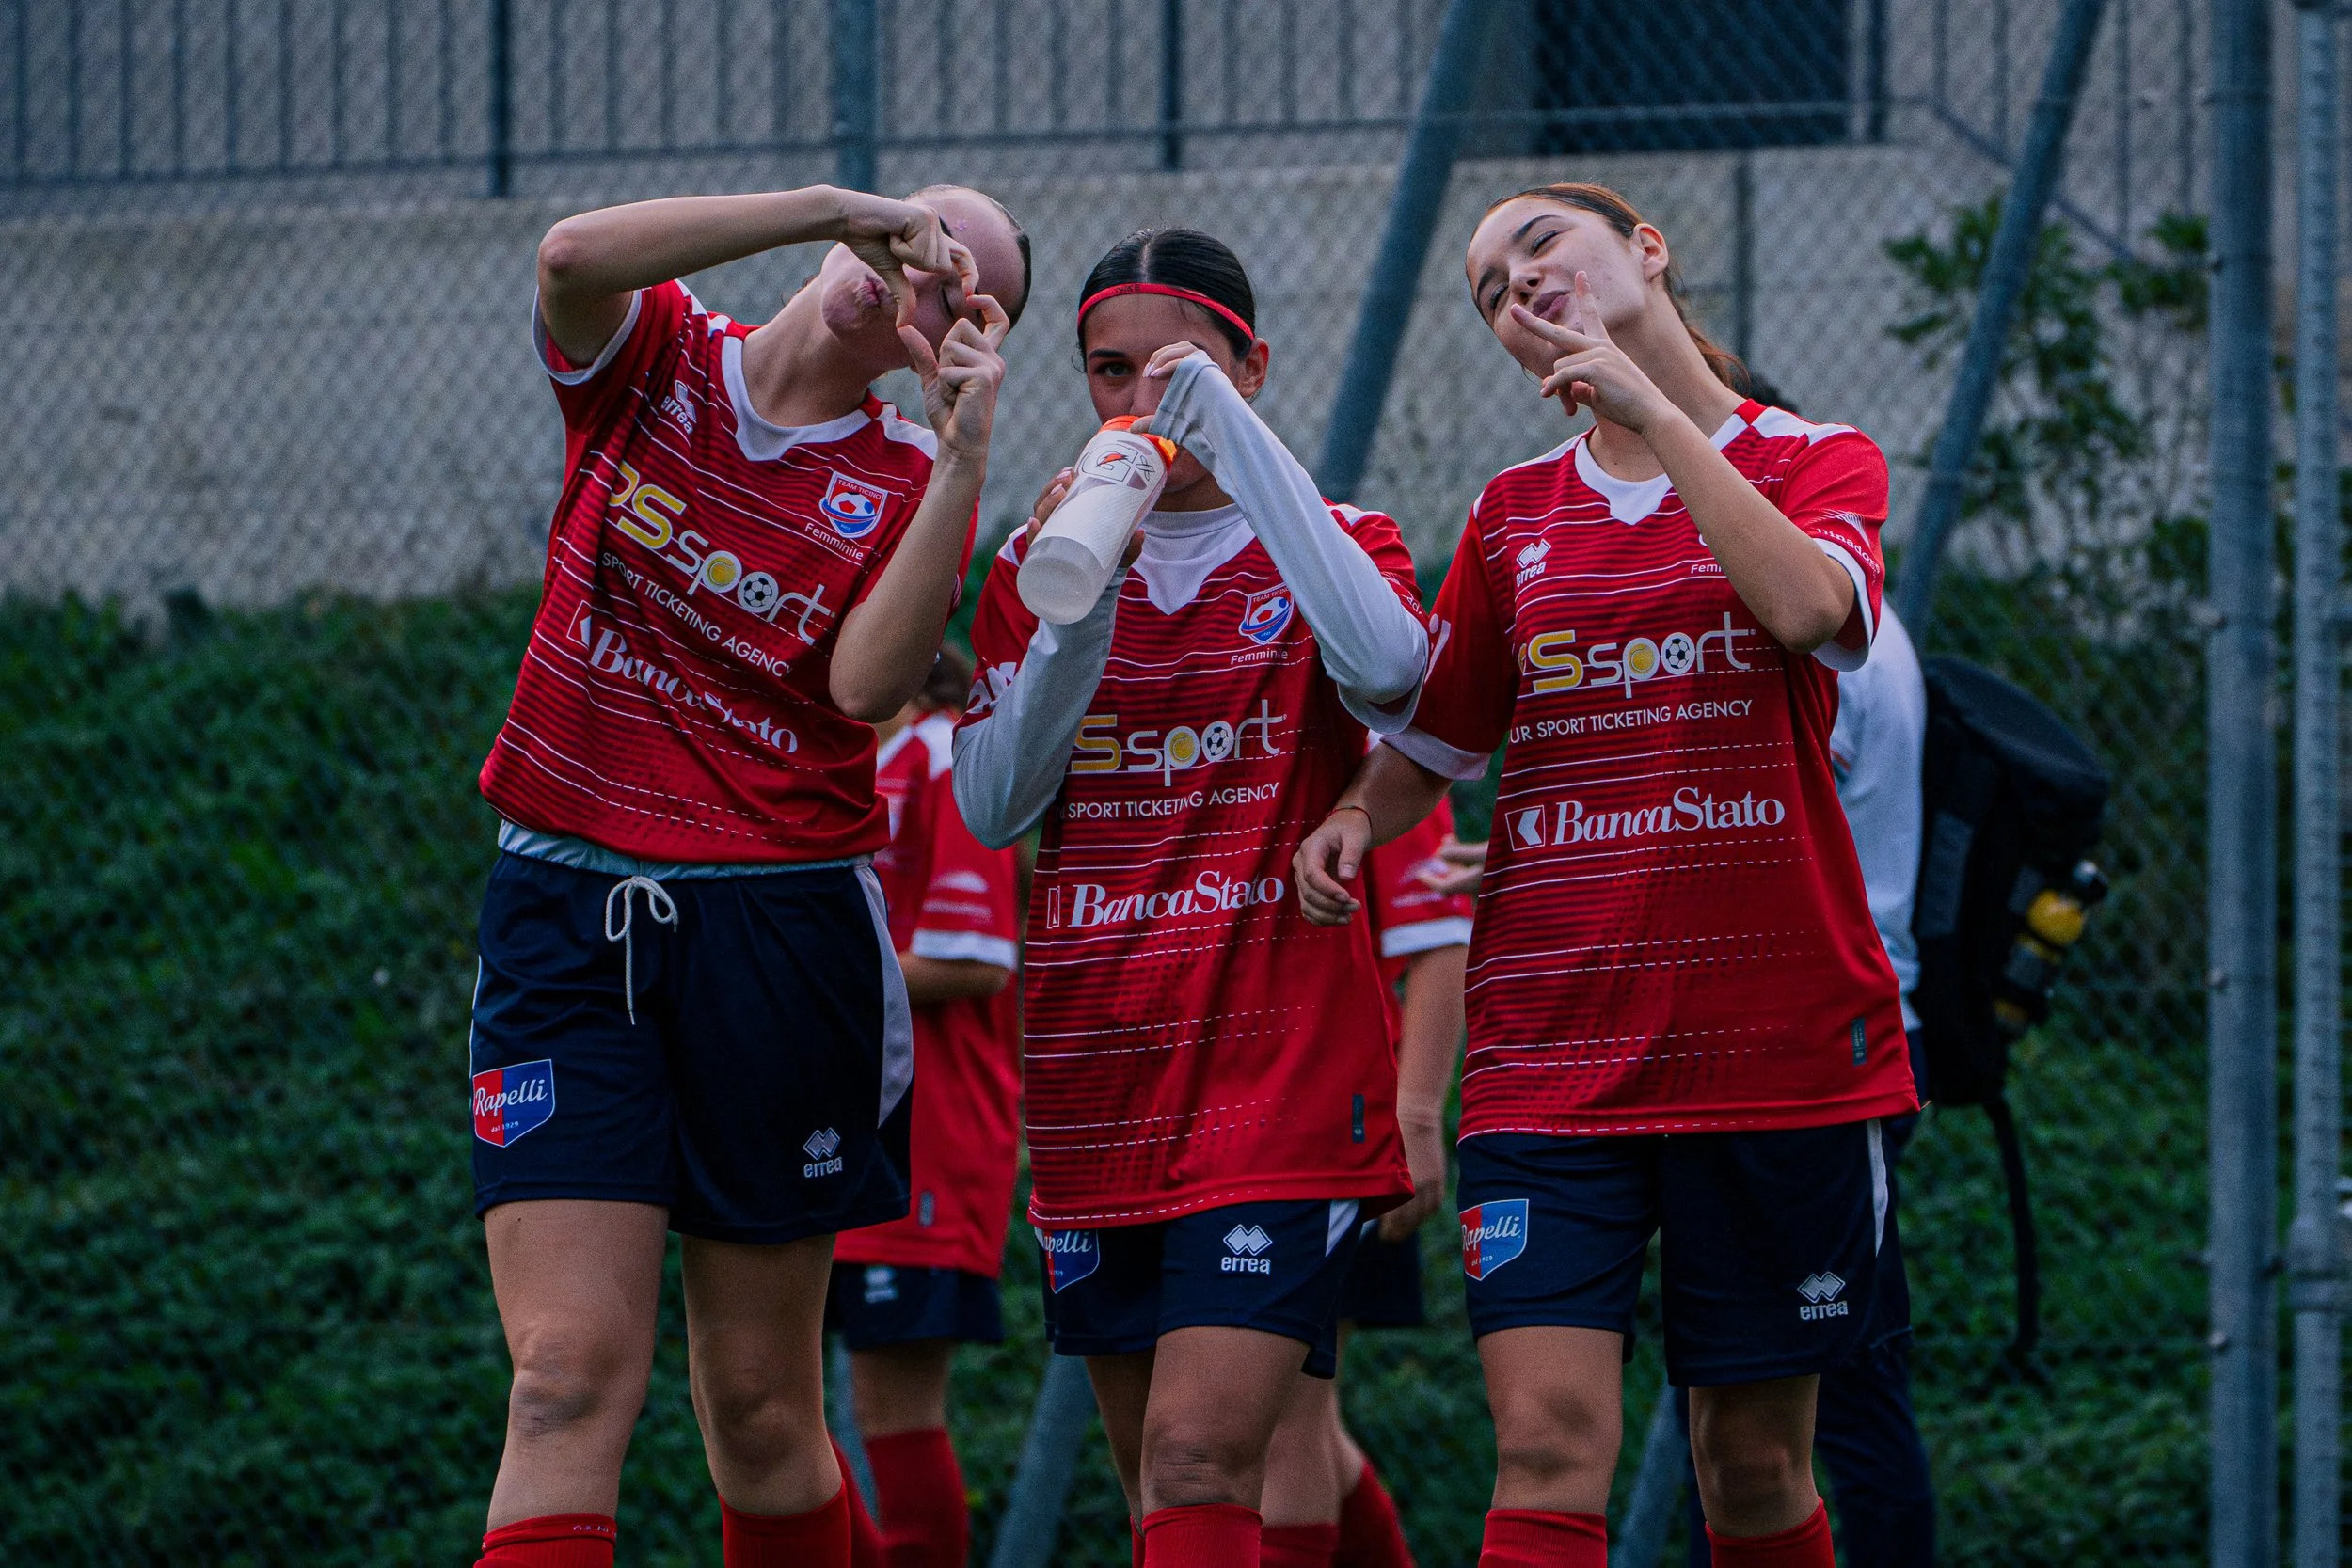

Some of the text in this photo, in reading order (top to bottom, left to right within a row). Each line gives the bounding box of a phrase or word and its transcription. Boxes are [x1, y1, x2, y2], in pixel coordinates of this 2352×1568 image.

[837, 479, 882, 499] TEAM TICINO
[804, 522, 864, 560] Femminile
[601, 551, 793, 678] SPORT TICKETING AGENCY
[1252, 594, 1270, 603] TEAM
[1536, 716, 1586, 738] SPORT
[1589, 705, 1672, 732] TICKETING
[1676, 699, 1753, 721] AGENCY
[1068, 801, 1120, 819] SPORT
[1125, 791, 1203, 818] TICKETING
[1209, 782, 1279, 806] AGENCY
[1551, 786, 1786, 846] BancaStato
[1067, 870, 1284, 927] BancaStato
[475, 1079, 548, 1117] Rapelli
[1461, 1215, 1521, 1252] Rapelli
